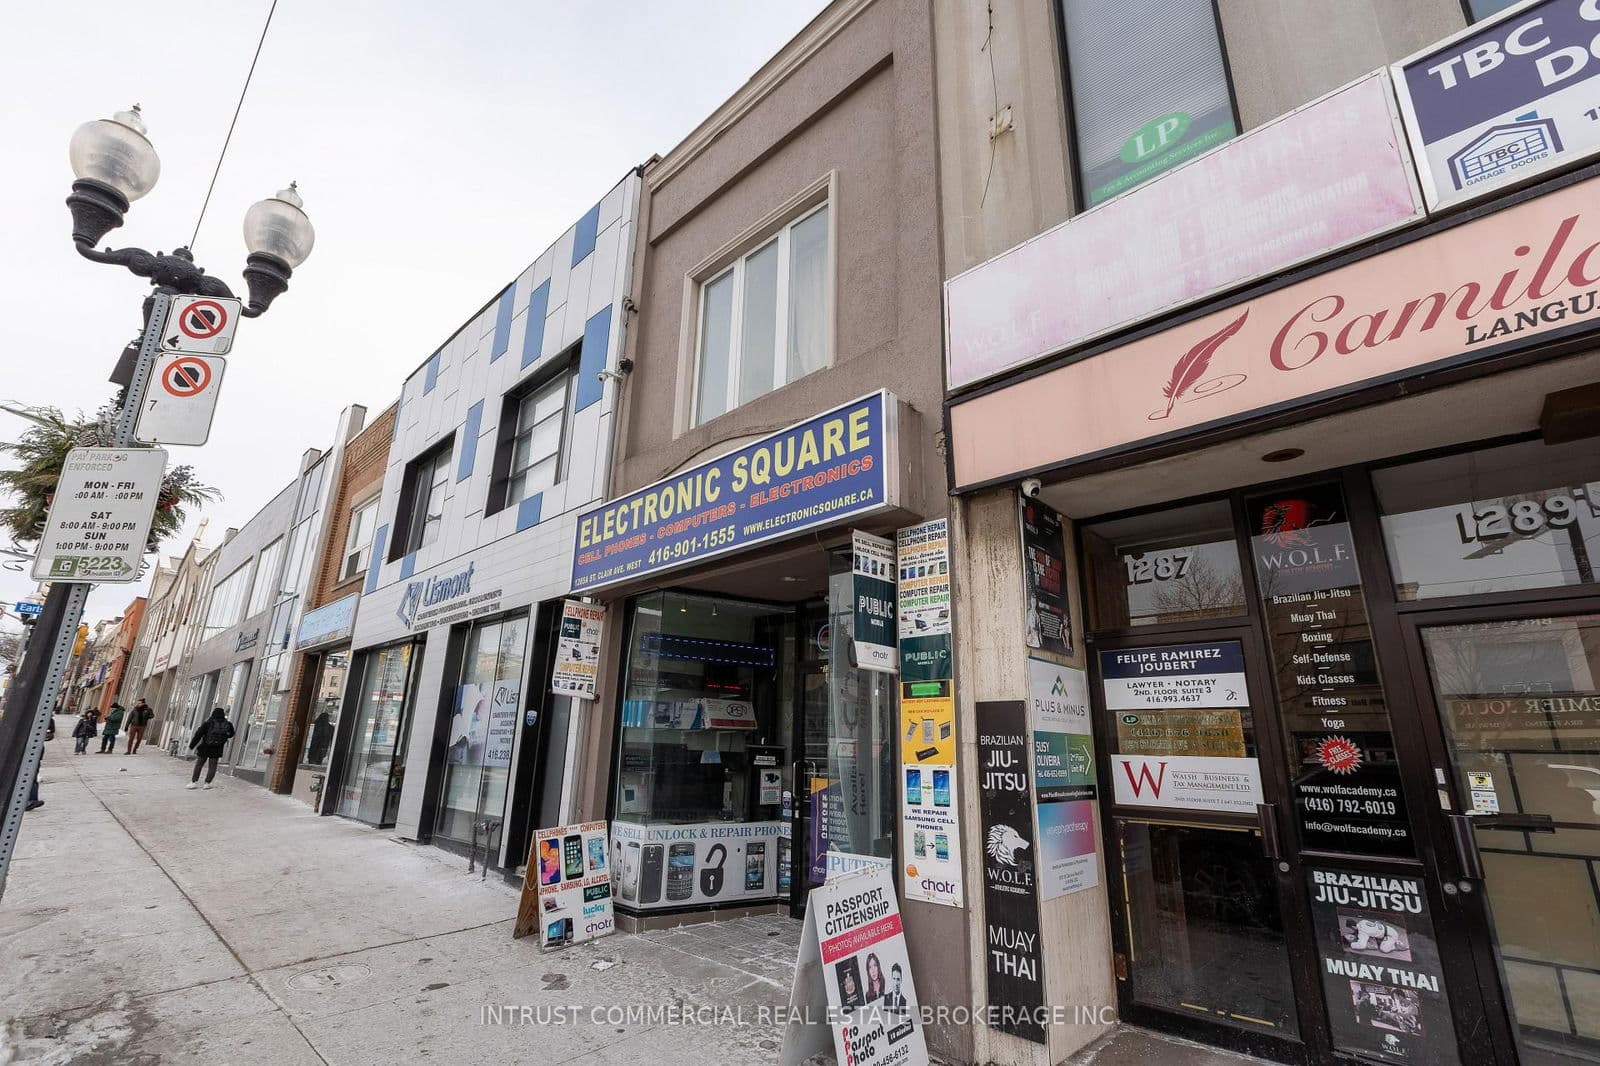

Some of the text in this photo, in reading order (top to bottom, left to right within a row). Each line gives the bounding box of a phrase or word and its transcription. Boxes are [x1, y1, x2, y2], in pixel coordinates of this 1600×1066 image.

[1427, 17, 1551, 90] TBC
[1134, 117, 1180, 159] LP
[1483, 143, 1521, 162] TBC
[1125, 158, 1169, 185] Accounting
[1466, 151, 1549, 186] GARAGE DOORS
[1465, 290, 1600, 346] LANGU
[68, 463, 113, 472] ENFORCED
[84, 481, 135, 490] MON FRI
[579, 406, 870, 549] ELECTRONIC SQUARE
[90, 491, 143, 500] AM PM
[90, 511, 112, 520] SAT
[577, 454, 874, 566] CELL PHONES COMPUTERS ELECTRONICS
[60, 521, 136, 531] 8:00 AM 9:00 PM
[927, 521, 946, 533] REPAIR
[1455, 495, 1577, 544] 1289
[84, 531, 107, 540] SUN
[626, 559, 642, 571] WEST
[648, 525, 736, 565] 416-901-1555
[743, 487, 874, 536] WWW.ELECTRONICSQUARE.CA
[927, 530, 947, 542] REPAIR
[55, 542, 129, 552] 1:00 PM 9:00 PM
[78, 556, 123, 570] 5223
[1261, 543, 1350, 570] W.O.L.F.
[1123, 551, 1194, 586] 1287
[423, 561, 475, 607] Lismont
[900, 583, 949, 599] COMPUTER REPAIR
[900, 593, 950, 609] COMPUTER REPAIR
[1272, 588, 1351, 605] Brazilian Jiu-Jitsu
[858, 595, 894, 620] PUBLIC
[1290, 609, 1337, 624] Muay Thai
[1301, 632, 1333, 643] Boxing
[872, 650, 889, 660] chatr
[905, 649, 947, 662] PUBLIC
[1116, 648, 1222, 664] FELIPE RAMIREZ
[1292, 652, 1351, 665] Self-Defense
[1140, 660, 1198, 674] JOUBERT
[1126, 678, 1217, 689] LAWYER NOTARY
[1296, 674, 1355, 685] Kids Classes
[1153, 685, 1212, 696] FLOOR SUITE 3
[1146, 694, 1201, 704] 416.993.4637
[1311, 695, 1347, 706] Fitness
[1035, 699, 1055, 713] PLUS
[1063, 703, 1085, 717] MINUS
[1321, 717, 1346, 730] Yoga
[980, 735, 1024, 746] BRAZILIAN
[1035, 741, 1050, 753] SUSY
[987, 750, 1019, 768] JIU-
[1036, 755, 1061, 767] OLIVEIRA
[982, 772, 1026, 791] JITSU
[1120, 760, 1169, 800] W
[1204, 774, 1240, 782] BUSINESS
[1299, 784, 1397, 798] www.wolfacademy.ca
[1304, 797, 1396, 816] (416) 792-6019
[904, 815, 936, 823] SAMSUNG
[916, 823, 944, 831] PHONES
[579, 822, 606, 833] COMPUTERS
[647, 829, 698, 841] UNLOCK
[699, 829, 709, 839] &
[710, 826, 752, 840] REPAIR
[1304, 820, 1407, 838] info@wolfacademy.ca
[987, 867, 1033, 887] W.O.L.F.
[1312, 870, 1419, 894] BRAZILIAN
[586, 884, 609, 897] PUBLIC
[921, 878, 955, 894] chatr
[826, 887, 884, 919] PASSPORT
[1314, 885, 1423, 914] JIU-JITSU
[582, 903, 605, 916] lucky
[585, 918, 612, 933] chatr
[825, 900, 890, 936] CITIZENSHIP
[828, 922, 895, 954] PHOTOS AVAILABLE HERE
[989, 925, 1035, 953] MUAY
[991, 950, 1037, 981] THAI
[1326, 957, 1440, 993] MUAY THAI
[842, 1026, 859, 1042] Pro
[845, 1023, 885, 1055] Passport
[847, 1046, 875, 1066] Photo
